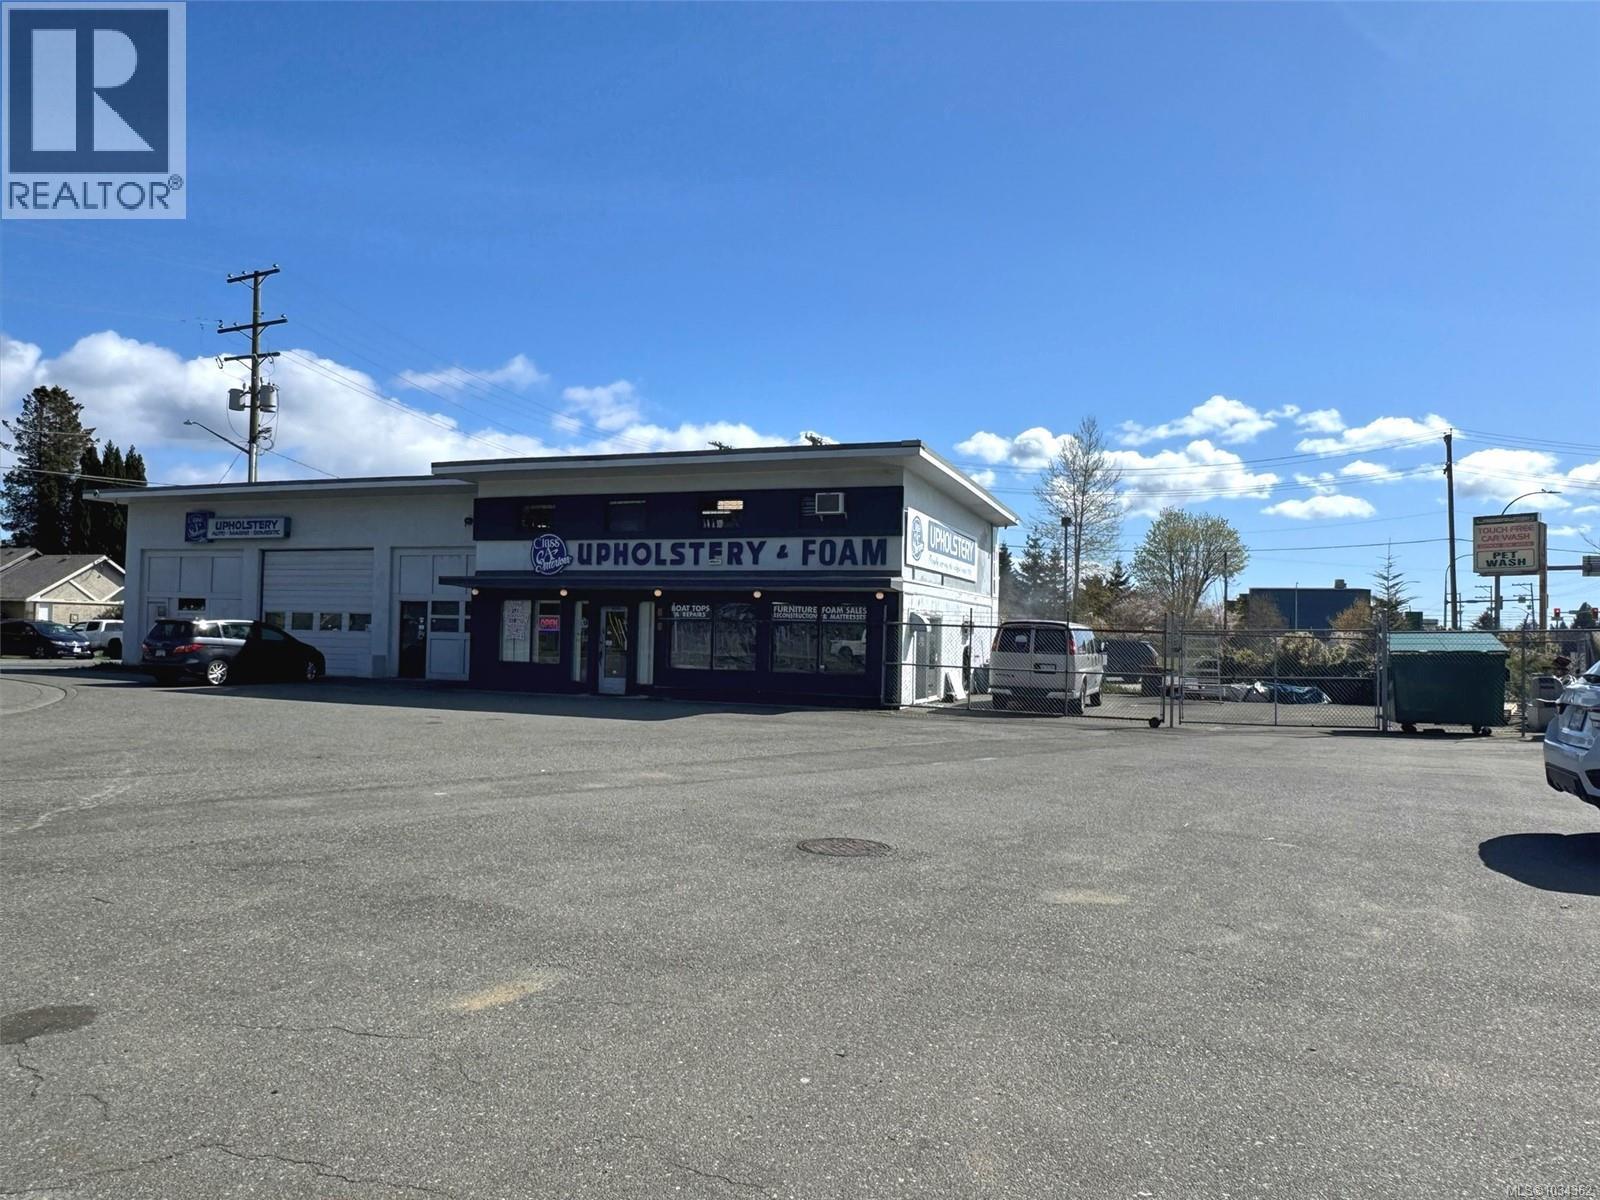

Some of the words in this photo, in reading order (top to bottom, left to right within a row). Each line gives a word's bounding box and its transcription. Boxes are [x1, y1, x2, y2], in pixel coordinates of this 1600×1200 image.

[215, 519, 279, 530] UPHOLSTERY
[1479, 526, 1508, 535] TOUCH
[1510, 524, 1535, 532] FREE
[1502, 533, 1530, 541] WASH
[929, 525, 975, 561] UPHOLSTERY
[578, 541, 767, 566] UPHOLSTERY
[776, 544, 789, 559] &
[802, 537, 888, 567] FOAM
[1493, 551, 1518, 559] PET
[1486, 558, 1526, 567] WASH
[671, 604, 690, 612] BOAT
[692, 604, 710, 612] TOPS
[773, 606, 818, 614] FURNITURE
[821, 606, 844, 614] FOAM
[846, 606, 867, 614] SALES
